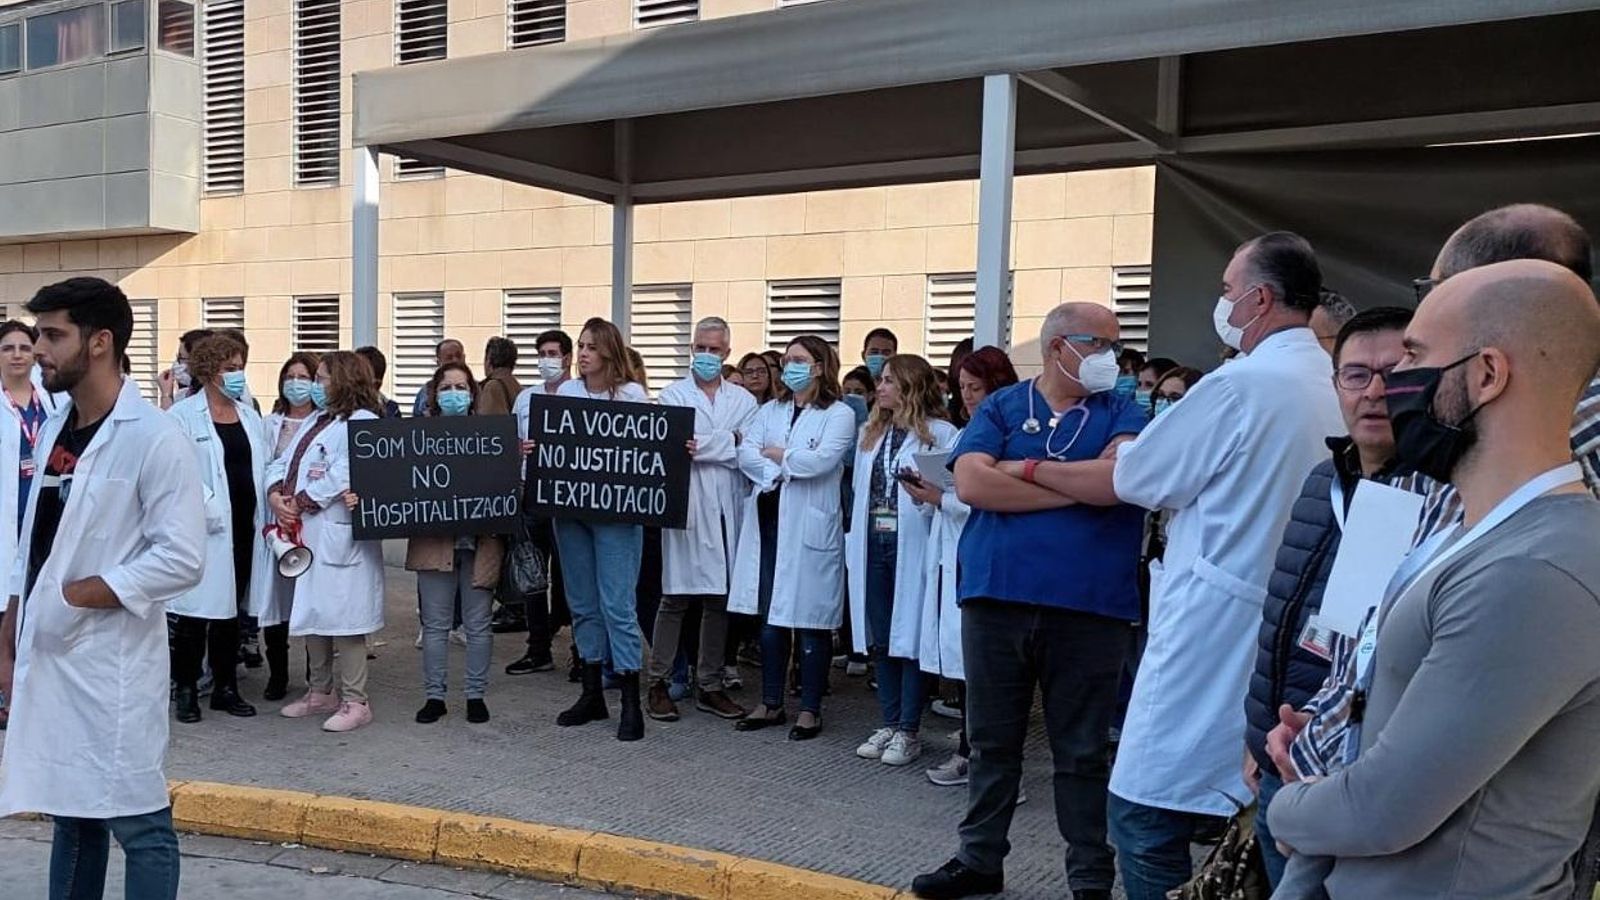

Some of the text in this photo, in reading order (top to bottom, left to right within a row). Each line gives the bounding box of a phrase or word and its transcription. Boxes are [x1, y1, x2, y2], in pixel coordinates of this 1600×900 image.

[543, 409, 668, 441] LA VOCACIÓ
[354, 429, 503, 459] SOM URGÈNCIES
[538, 443, 667, 476] NO JUSTIFICA
[412, 463, 451, 489] NO
[361, 489, 518, 528] HOSPITALITZACIÓ
[536, 479, 667, 515] L'EXPLOTACIÓ
